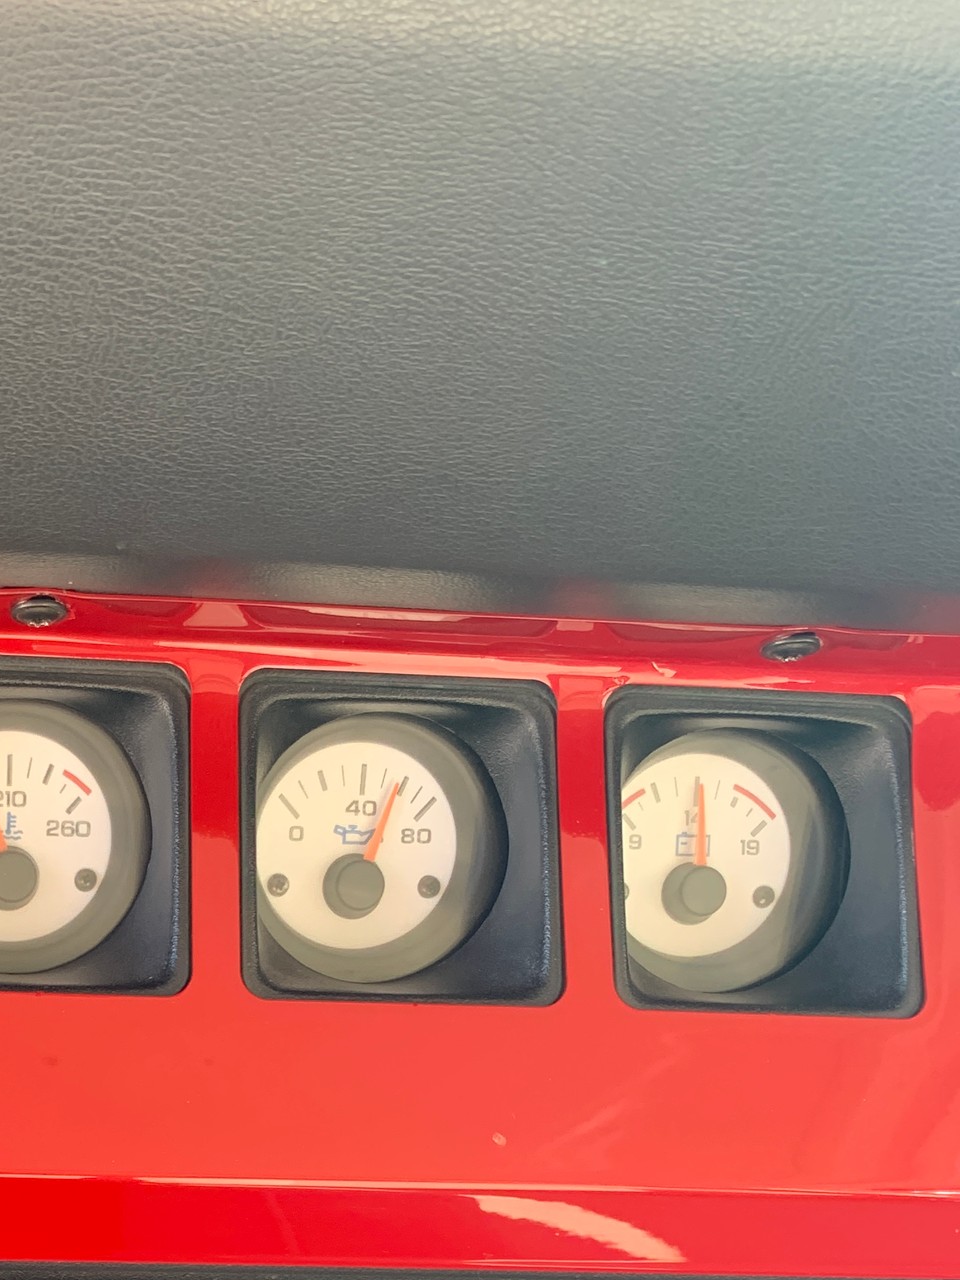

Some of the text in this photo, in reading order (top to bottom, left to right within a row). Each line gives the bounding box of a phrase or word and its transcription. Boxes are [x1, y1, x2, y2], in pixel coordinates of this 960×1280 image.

[345, 800, 377, 816] 40
[46, 820, 91, 838] 260
[288, 825, 304, 842] 0
[400, 828, 432, 844] 80
[628, 834, 642, 850] 9
[740, 839, 760, 855] 19
